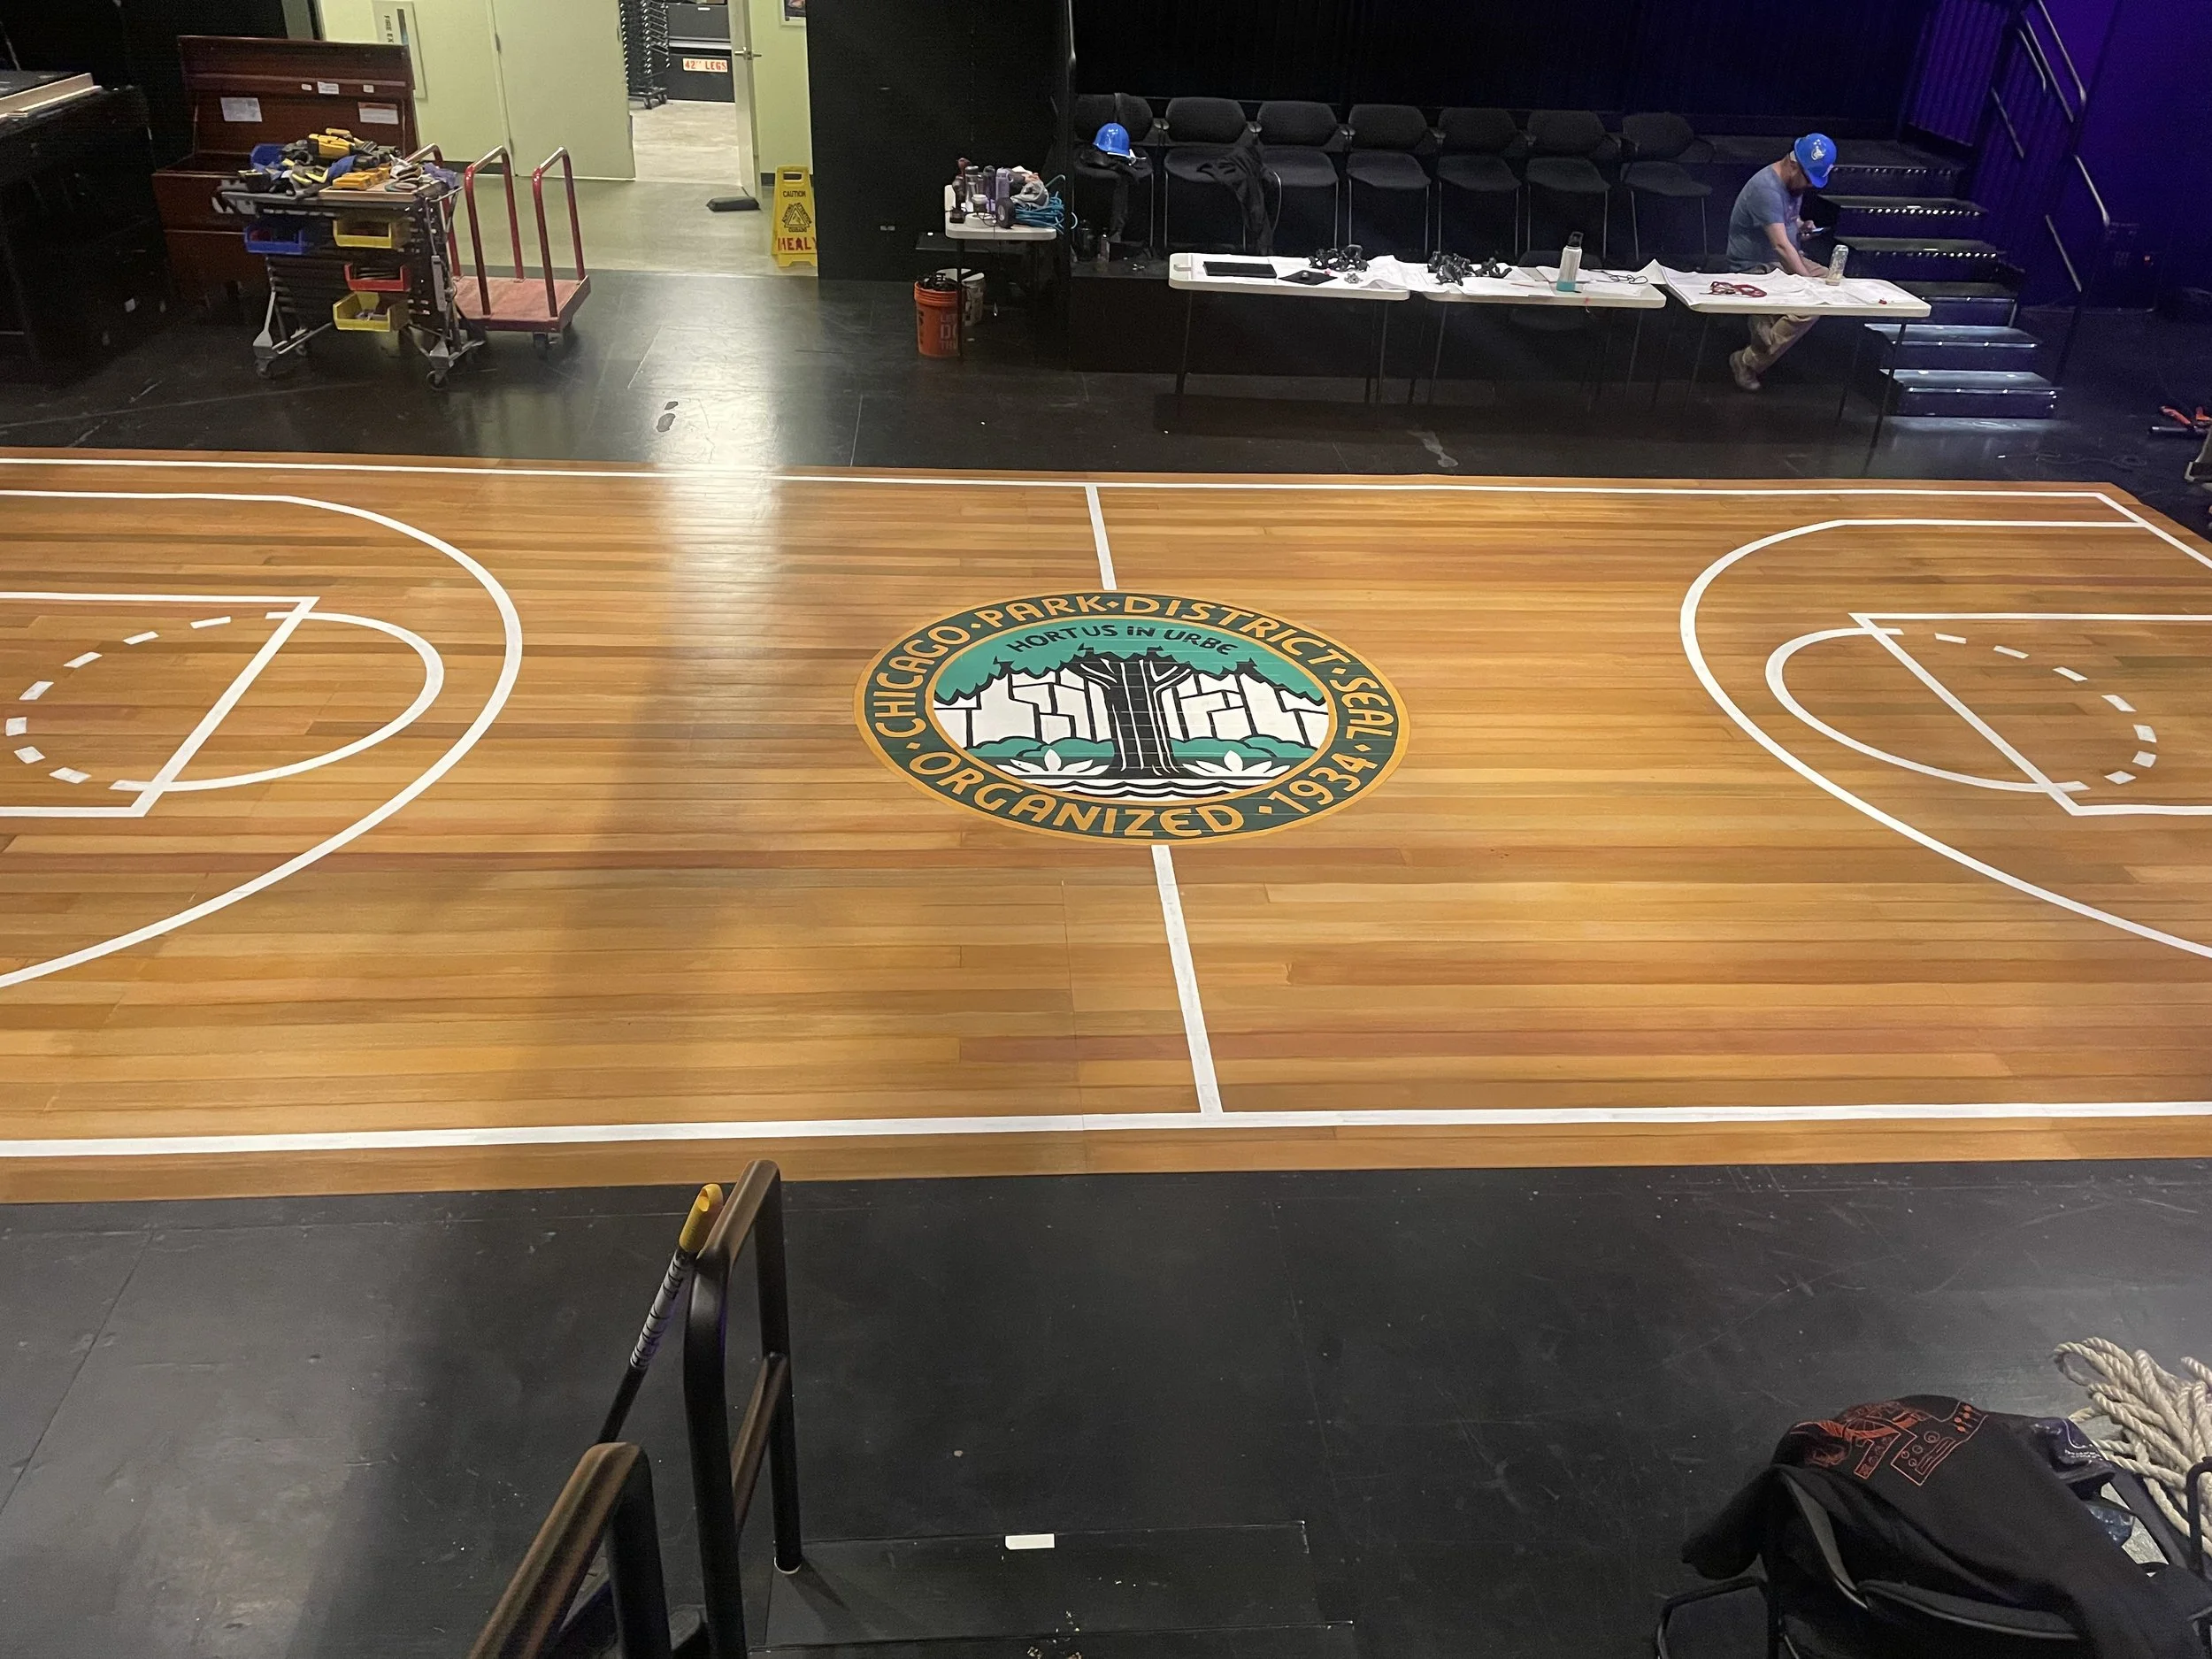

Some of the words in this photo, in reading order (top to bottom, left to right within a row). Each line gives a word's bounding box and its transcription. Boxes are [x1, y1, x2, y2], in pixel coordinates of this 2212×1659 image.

[705, 61, 726, 70] LEGS
[872, 626, 971, 738] CHICAGO
[973, 595, 1108, 628] PARK
[1124, 595, 1351, 664] DISTRICT
[1329, 677, 1394, 740] SEAL
[1006, 624, 1118, 653] HORTUS
[1163, 629, 1239, 656] URBE
[908, 751, 1245, 837] ORGANIZED
[1267, 753, 1379, 814] 1934
